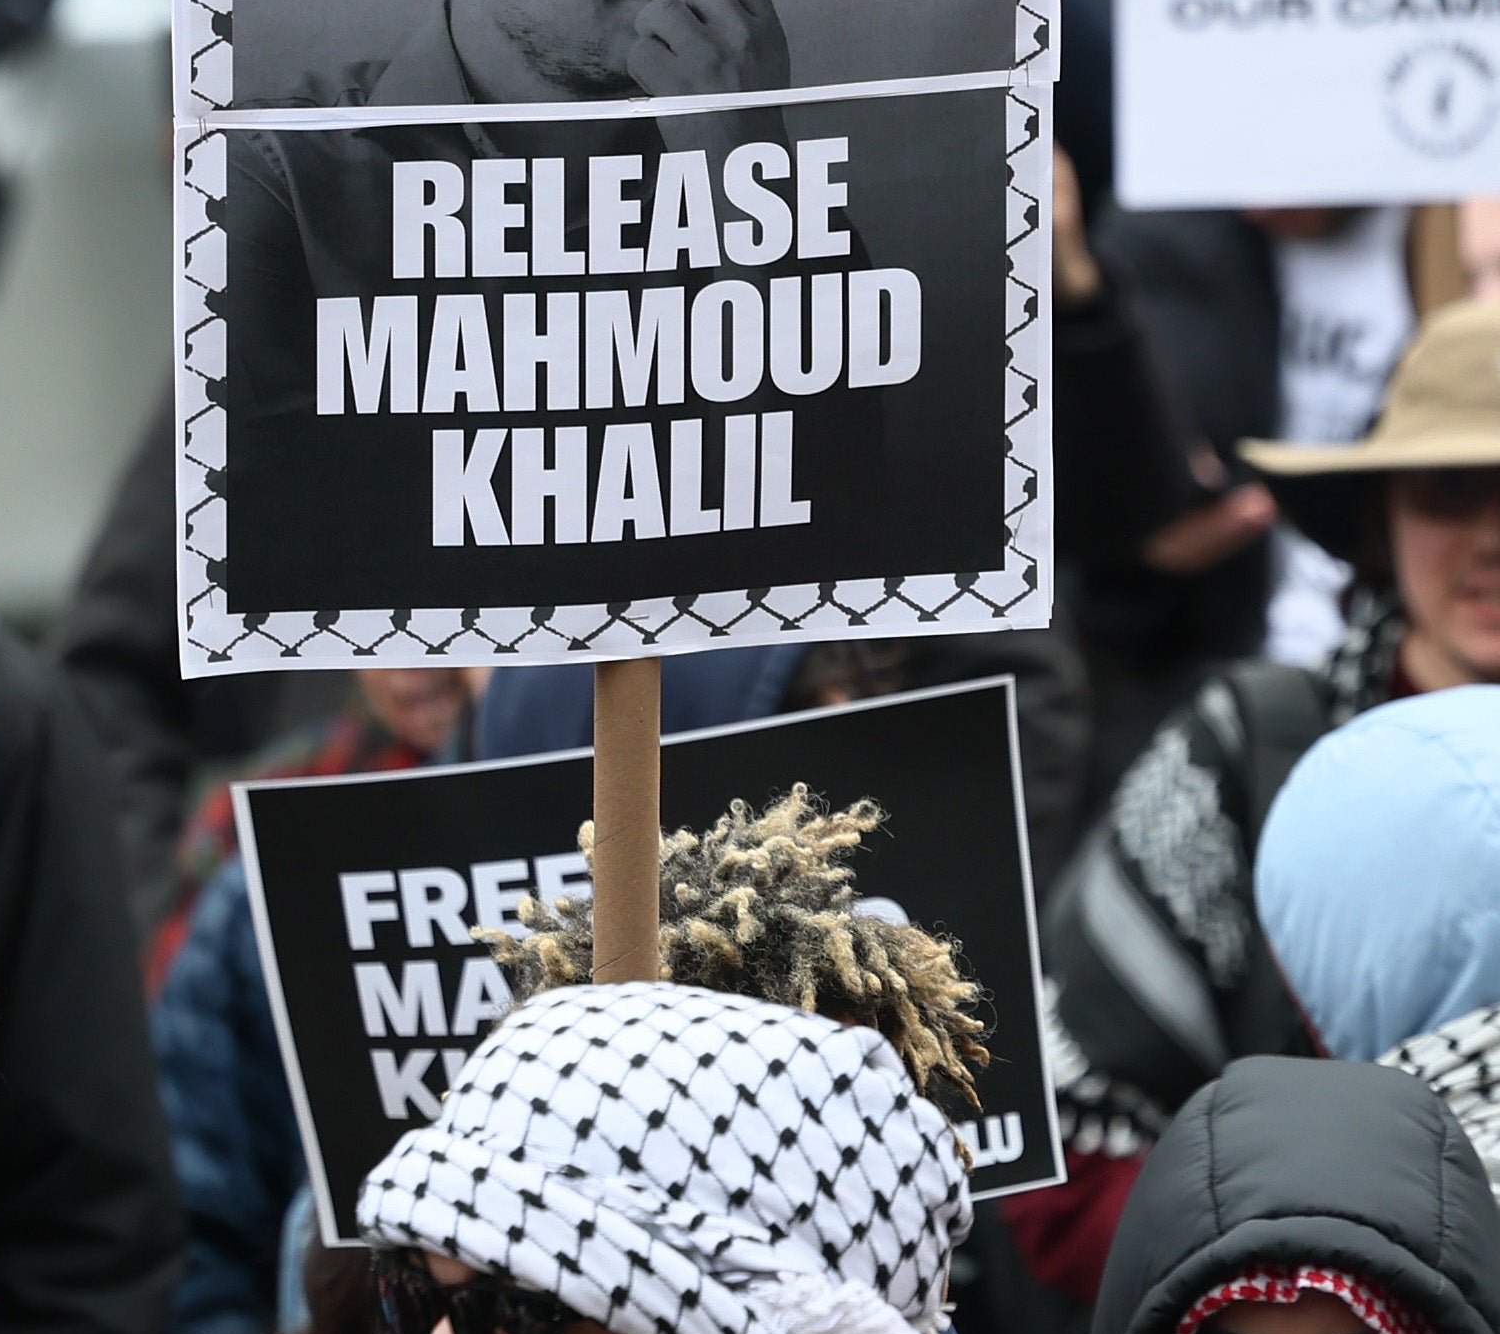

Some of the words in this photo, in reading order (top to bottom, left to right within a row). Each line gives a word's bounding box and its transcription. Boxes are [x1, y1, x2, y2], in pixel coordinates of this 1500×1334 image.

[392, 136, 851, 279] RELEASE
[316, 267, 922, 416] MAHMOUD
[432, 410, 812, 547] KHALIL
